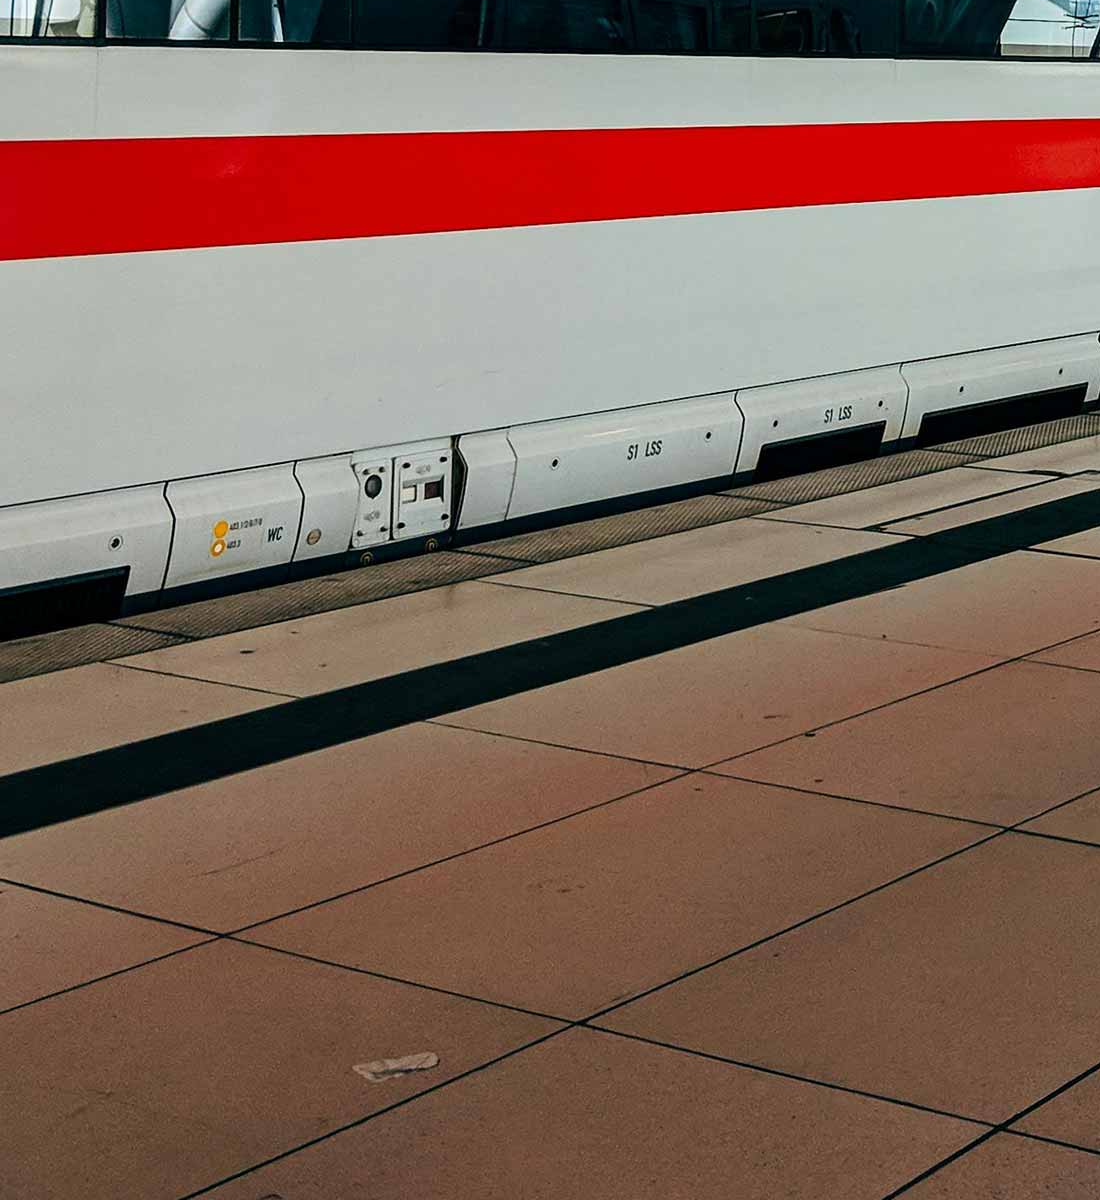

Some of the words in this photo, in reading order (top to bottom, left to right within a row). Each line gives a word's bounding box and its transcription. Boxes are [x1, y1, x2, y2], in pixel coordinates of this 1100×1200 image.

[824, 408, 833, 424] S1
[838, 405, 852, 421] LSS
[627, 444, 639, 460] S1
[645, 440, 662, 457] LSS
[267, 526, 283, 543] WC
